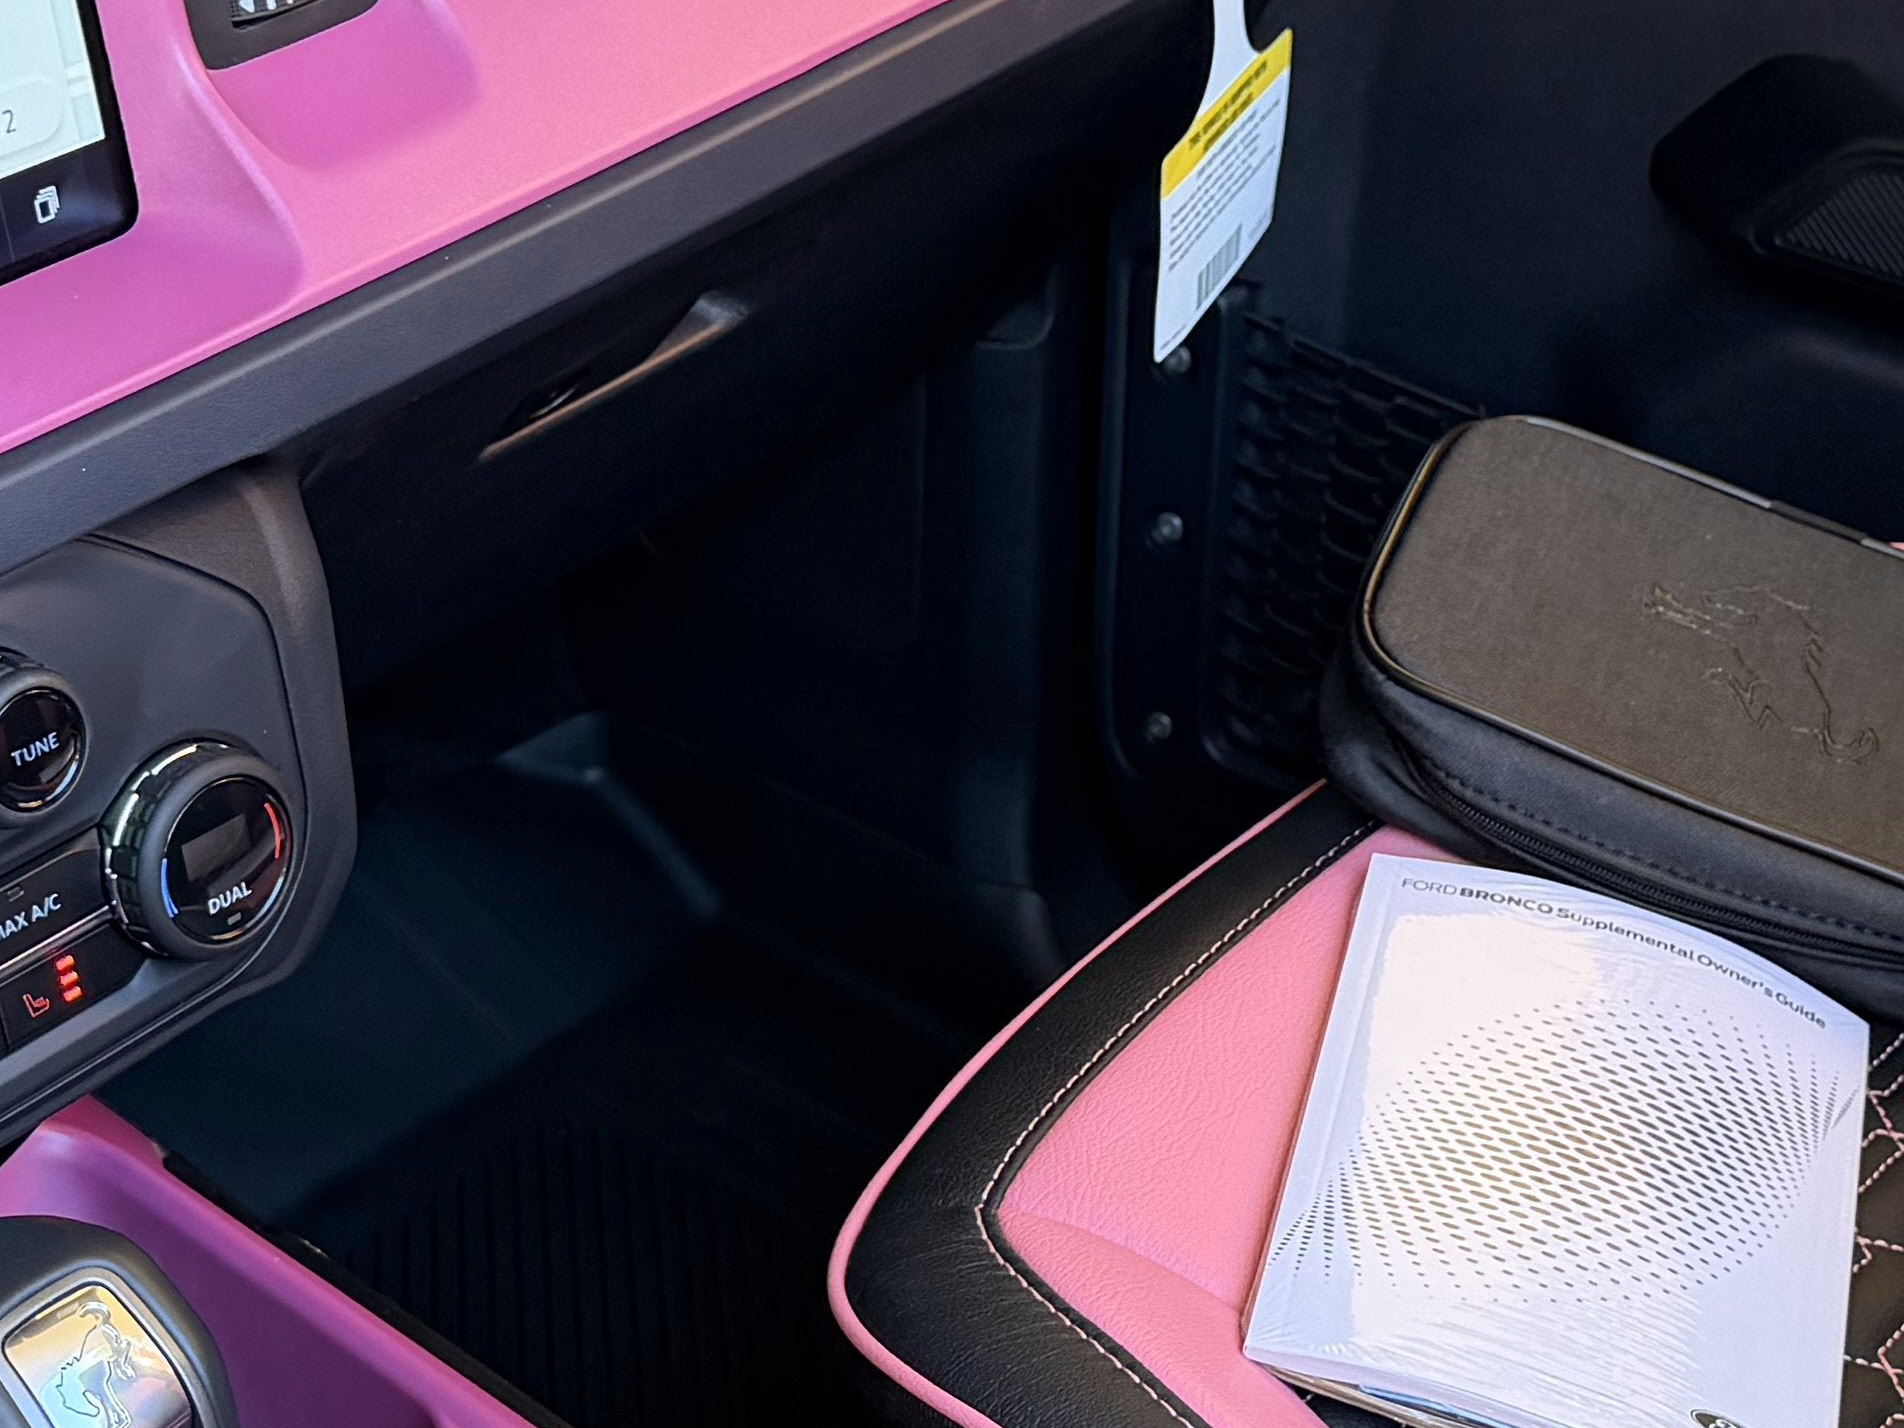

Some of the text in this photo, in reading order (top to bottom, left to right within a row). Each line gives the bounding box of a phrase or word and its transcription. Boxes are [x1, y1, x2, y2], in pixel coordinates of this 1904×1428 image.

[2, 109, 16, 133] 2
[11, 732, 60, 767] TUNE
[27, 892, 61, 926] A/C
[208, 882, 252, 915] DUAL
[1401, 877, 1826, 1029] FORD BRONCO Supplemental Owner's Guide
